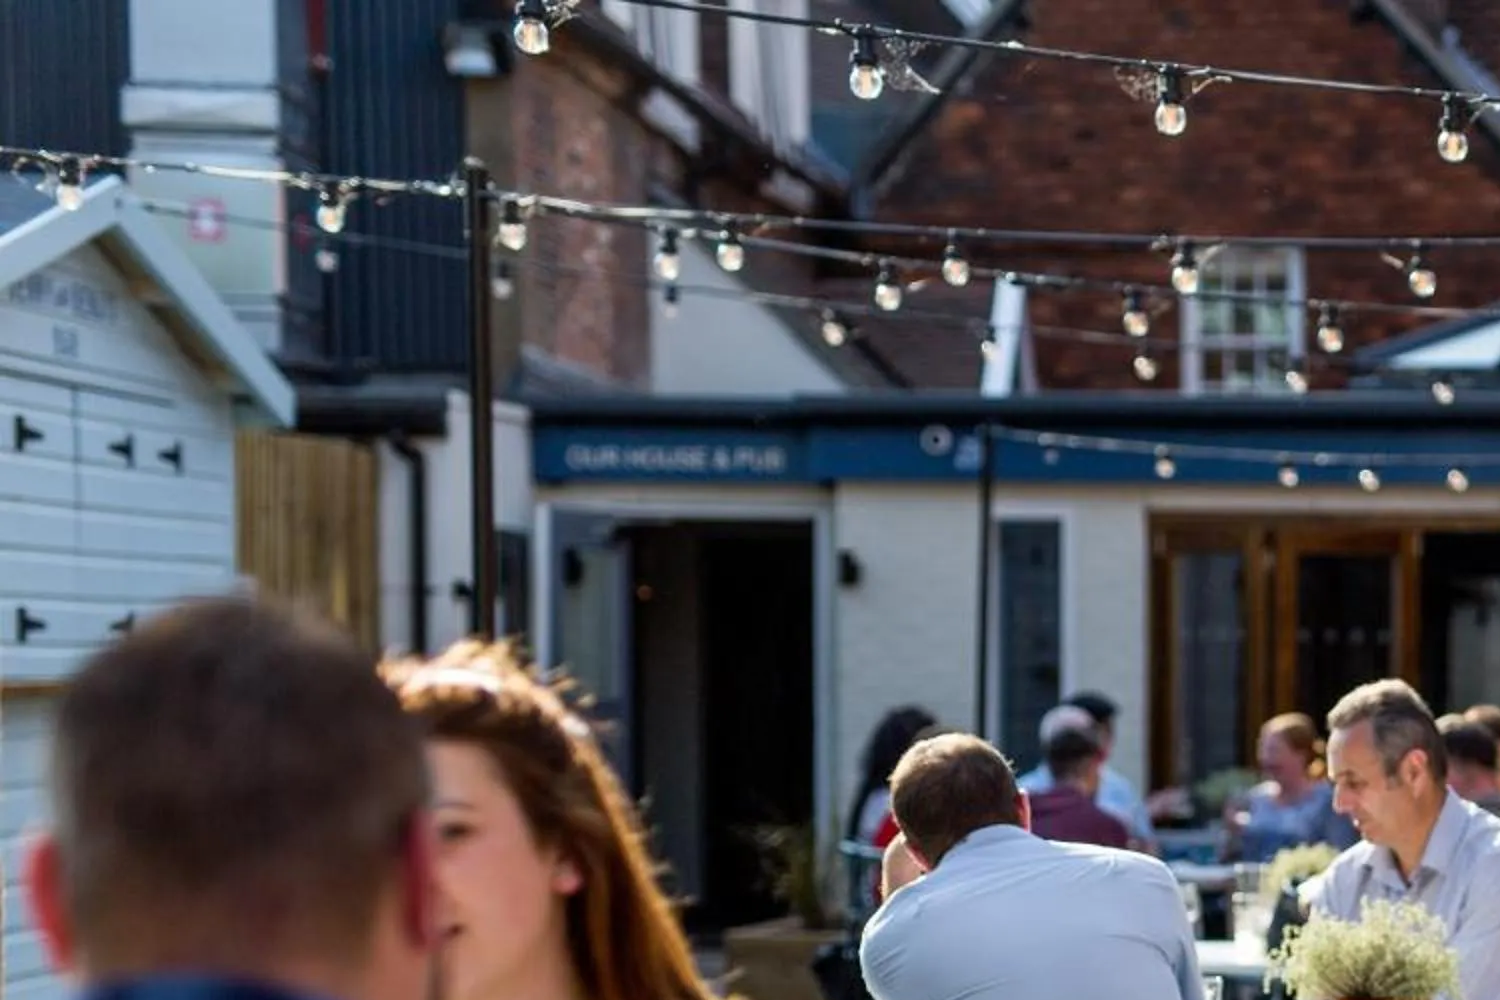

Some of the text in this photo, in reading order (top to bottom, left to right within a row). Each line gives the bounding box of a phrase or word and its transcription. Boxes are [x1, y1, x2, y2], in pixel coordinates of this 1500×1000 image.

[624, 446, 707, 470] HOUSE
[713, 447, 729, 471] &
[734, 447, 786, 472] PUB
